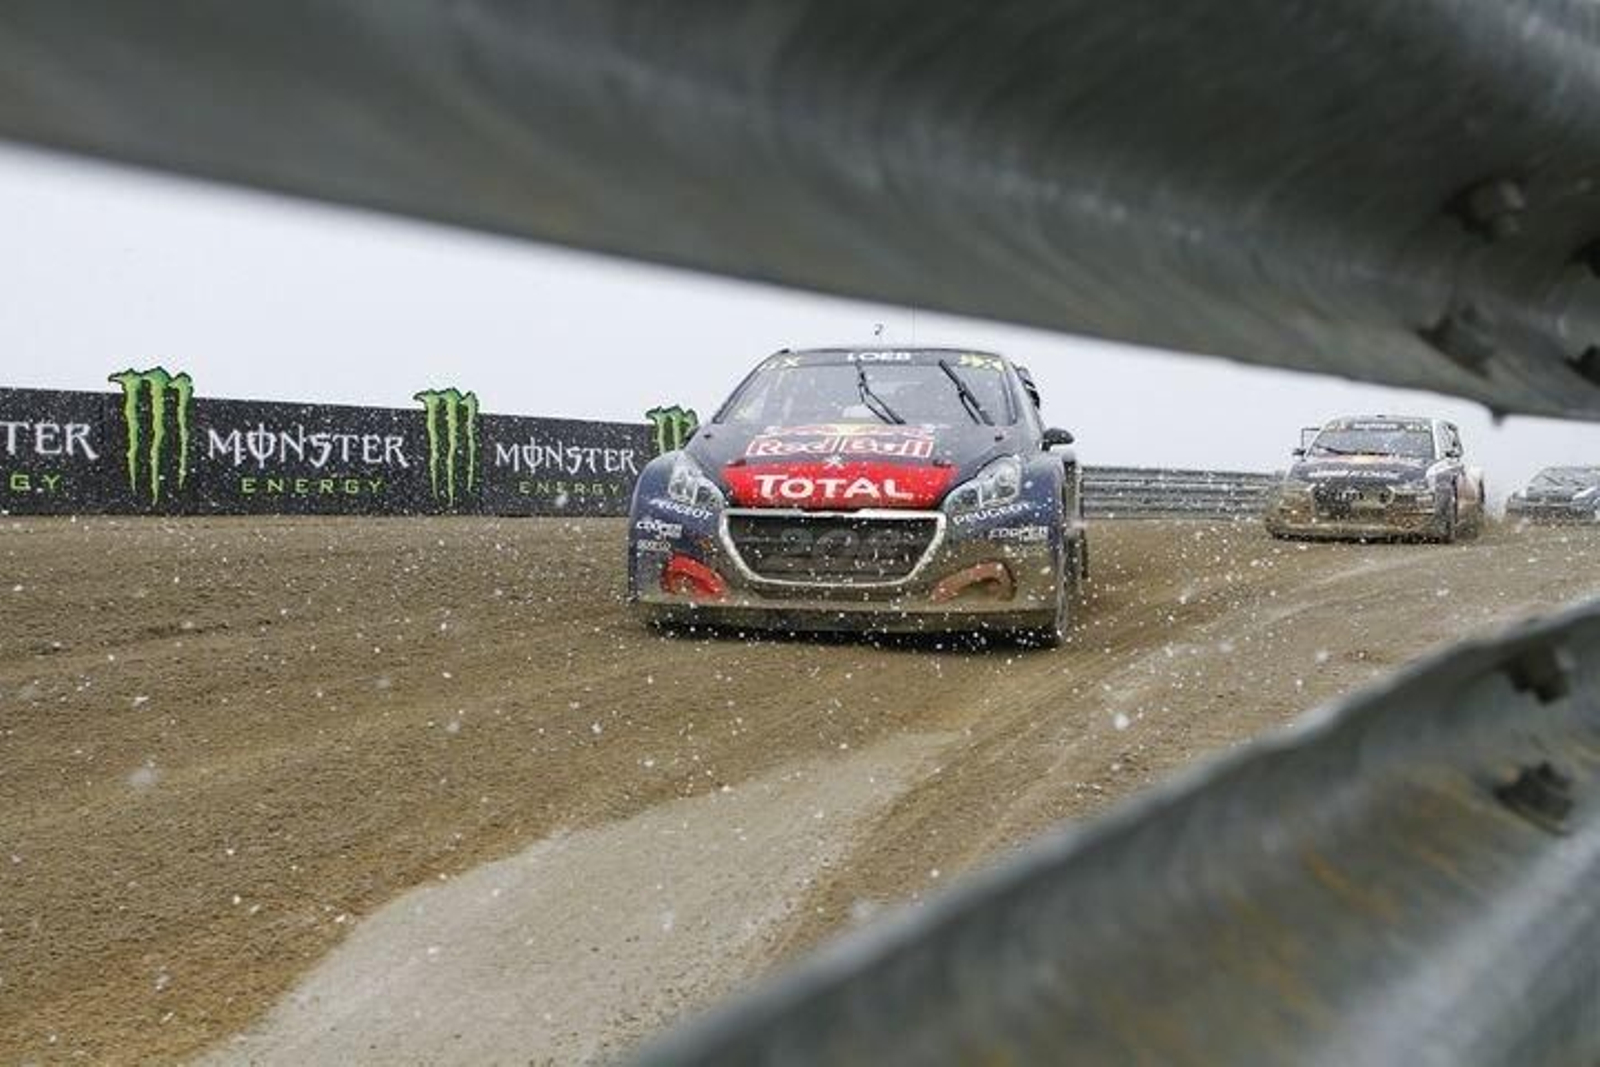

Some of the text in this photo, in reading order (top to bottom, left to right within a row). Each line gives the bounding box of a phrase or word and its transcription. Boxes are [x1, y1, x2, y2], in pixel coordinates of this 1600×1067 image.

[847, 352, 911, 362] LOEB
[0, 420, 99, 460] TER
[207, 422, 410, 469] MONSTER
[746, 434, 934, 458] Red Bull
[495, 436, 638, 475] MONSTER
[10, 474, 61, 491] GY
[240, 477, 384, 495] ENERGY
[518, 480, 621, 496] ENERGY
[754, 474, 913, 499] TOTAL
[649, 499, 713, 520] PEUGEOT
[953, 502, 1029, 525] PEUGEOT
